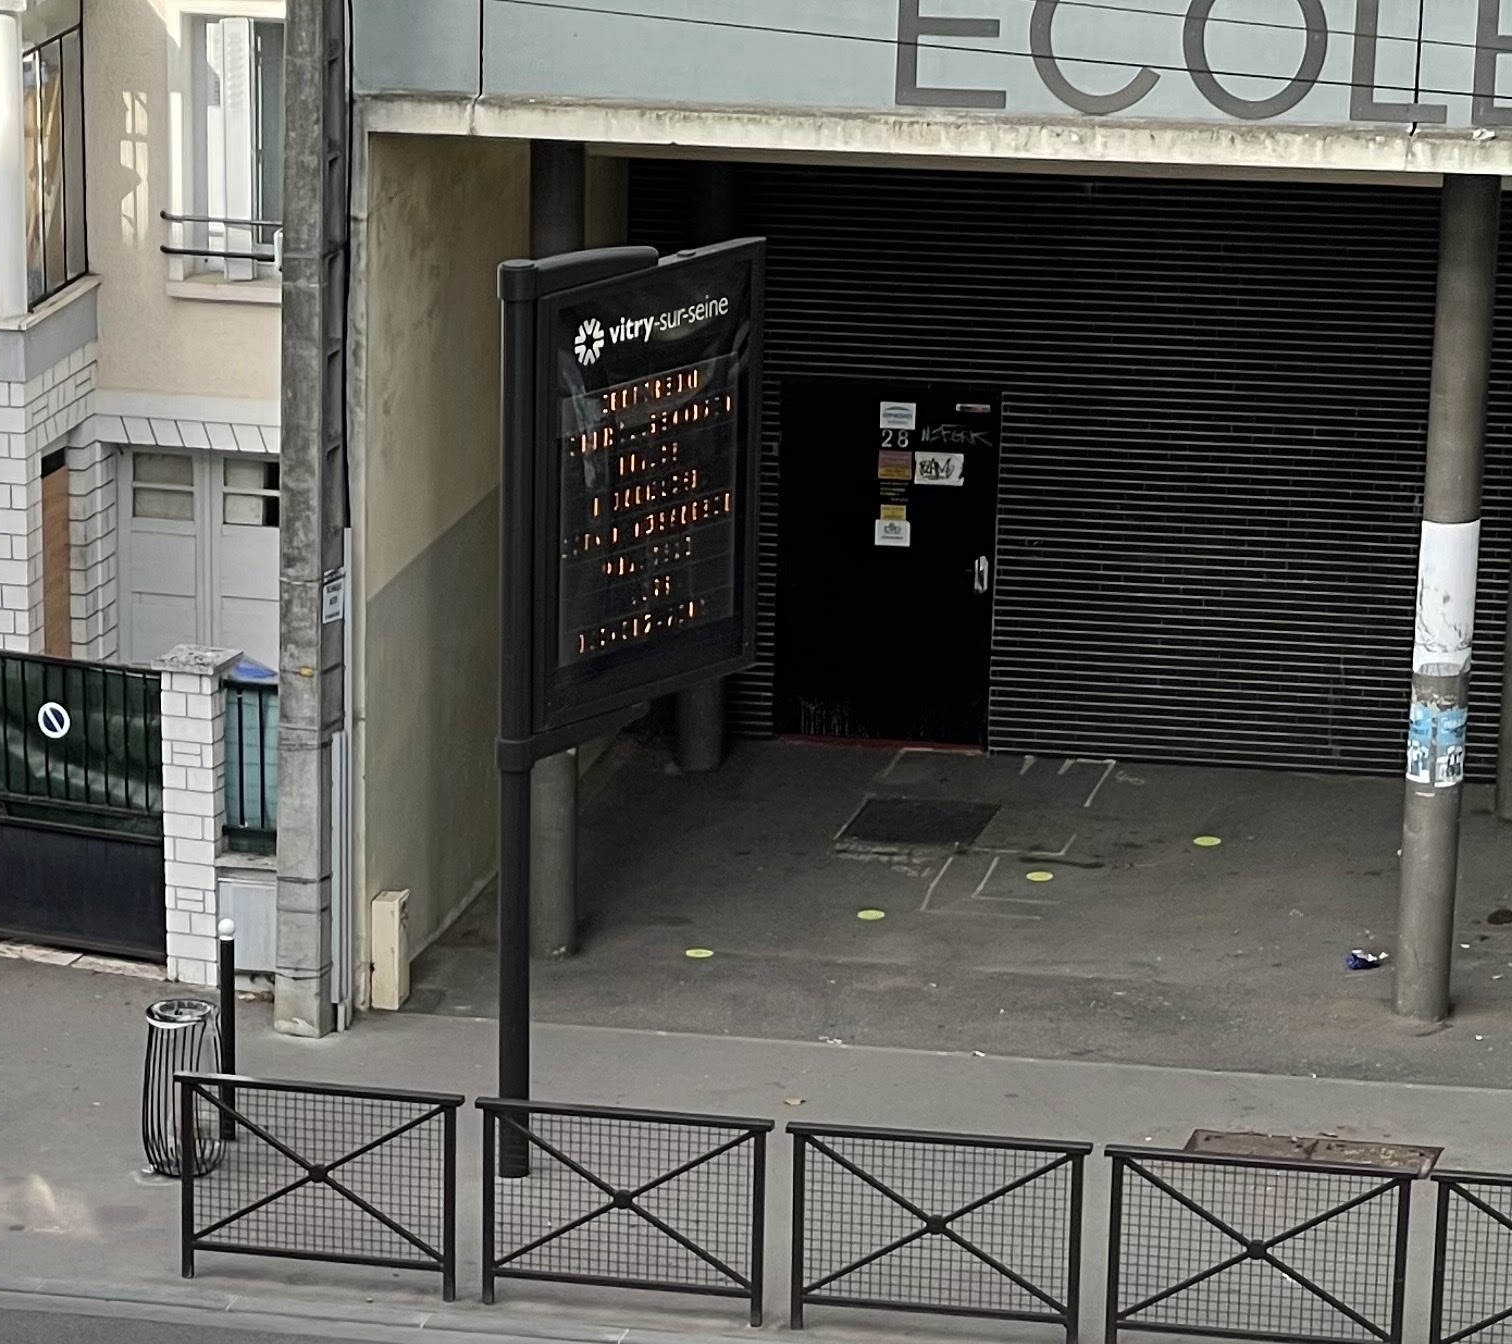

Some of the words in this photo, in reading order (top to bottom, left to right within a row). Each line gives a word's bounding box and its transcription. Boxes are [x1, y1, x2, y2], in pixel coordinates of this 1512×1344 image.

[895, 0, 1512, 125] ECOL
[609, 295, 729, 343] vitry-sur-seine
[881, 429, 909, 448] 28
